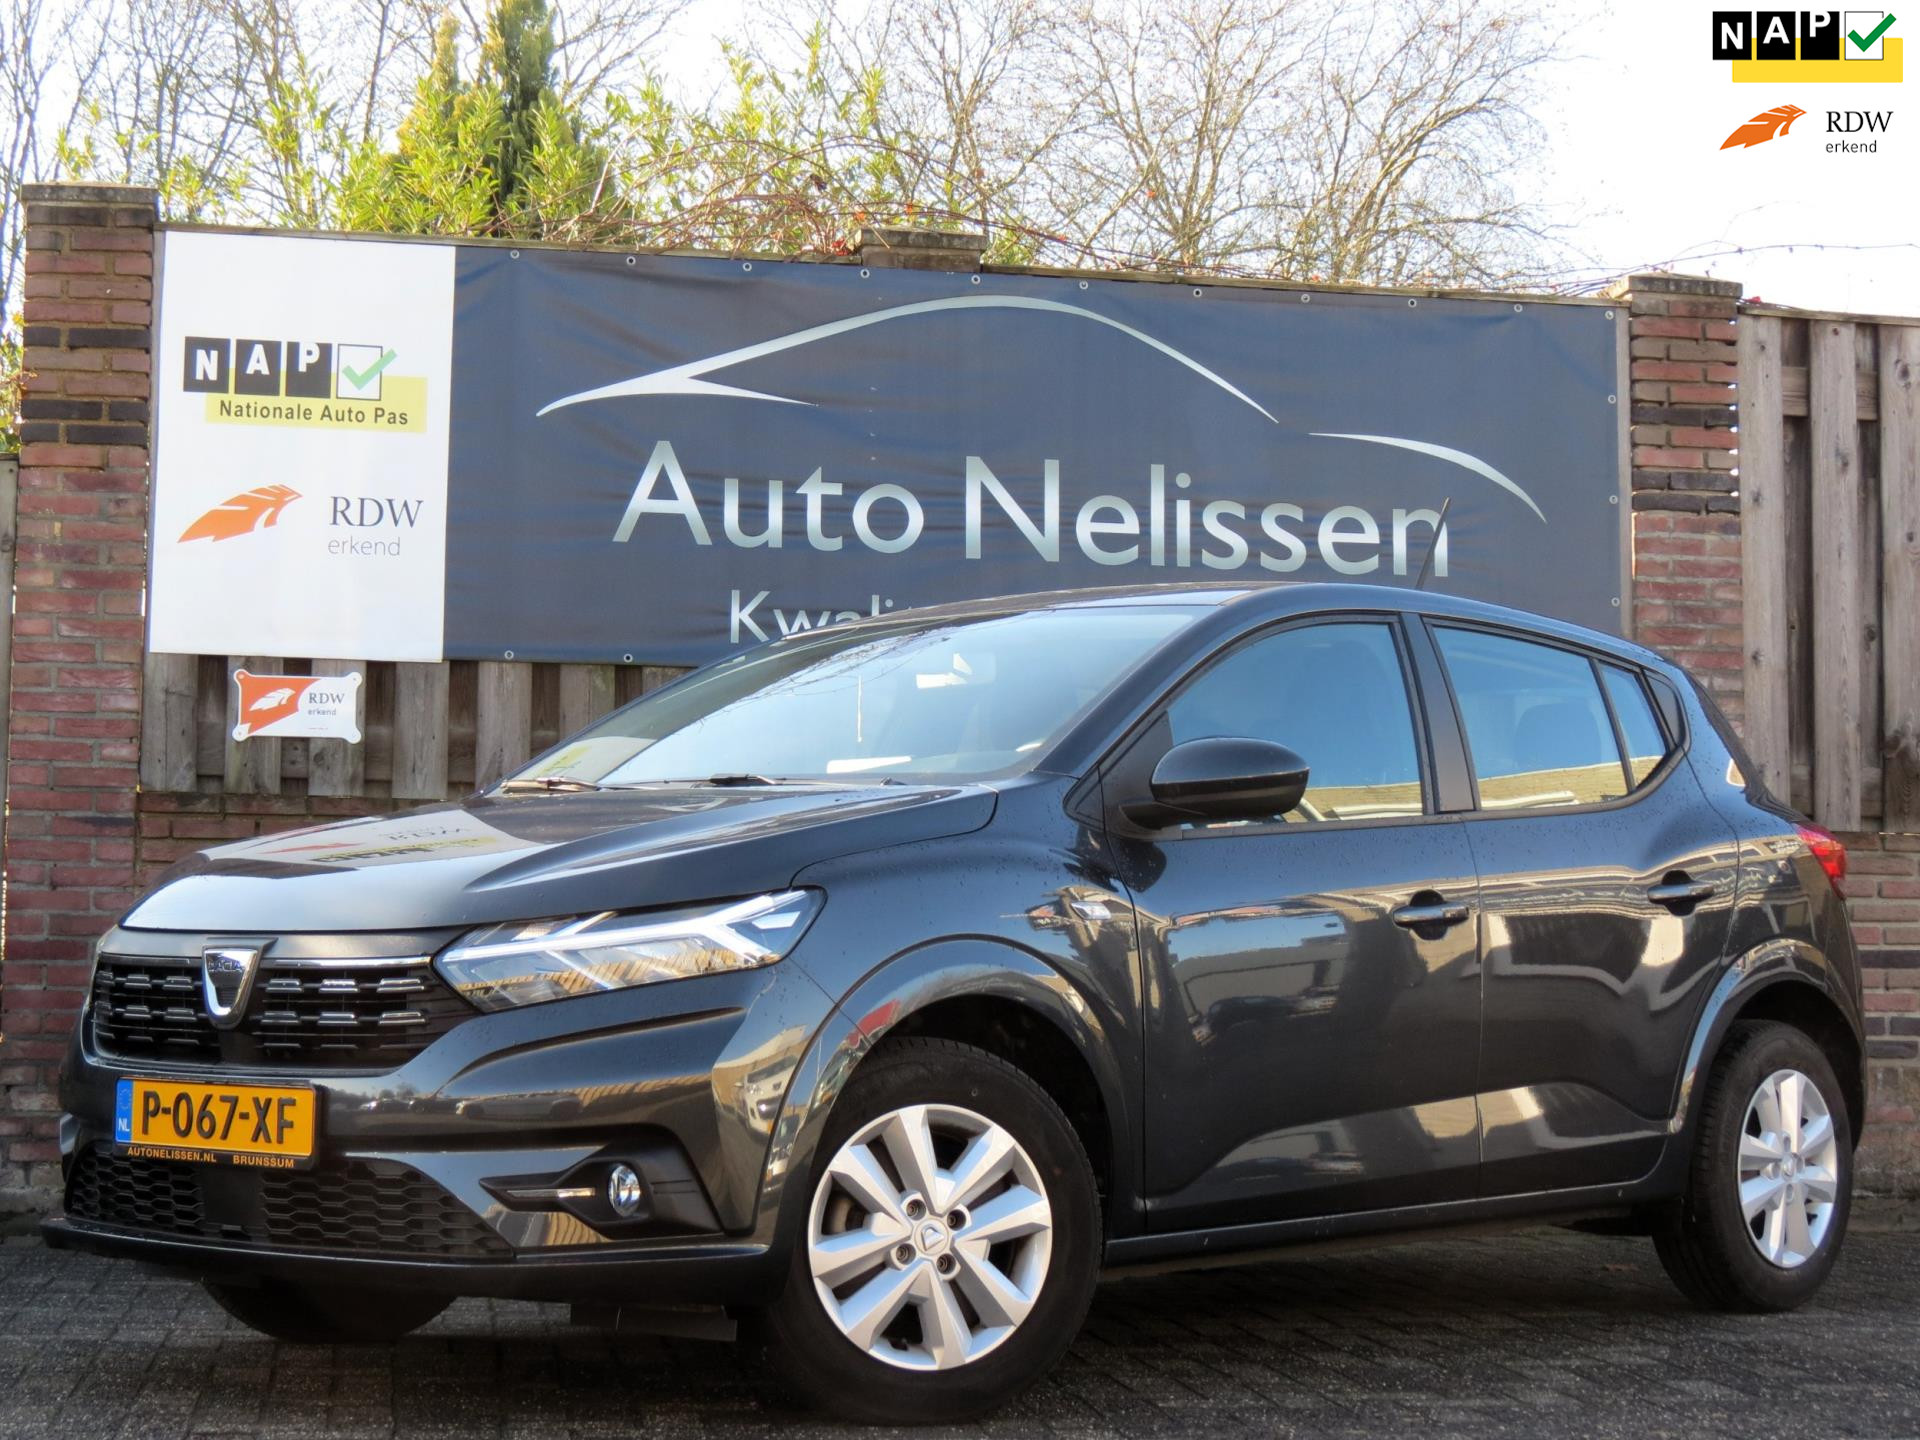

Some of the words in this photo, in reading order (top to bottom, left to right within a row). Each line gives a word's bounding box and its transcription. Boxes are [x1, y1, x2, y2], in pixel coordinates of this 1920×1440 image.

[195, 342, 321, 381] NAP
[220, 400, 312, 421] Nationale
[320, 405, 365, 424] Auto
[375, 408, 409, 425] Pas
[329, 496, 424, 528] RDW
[612, 440, 925, 554] Auto
[965, 455, 1449, 577] Nelissen
[328, 535, 400, 556] erkend
[308, 692, 345, 704] RDW
[308, 707, 337, 716] erkend
[118, 1117, 130, 1132] NL
[142, 1090, 297, 1144] P-067-XF
[127, 1146, 217, 1163] AUTONELISSEN.NL
[233, 1154, 294, 1169] BRUNSSUM
